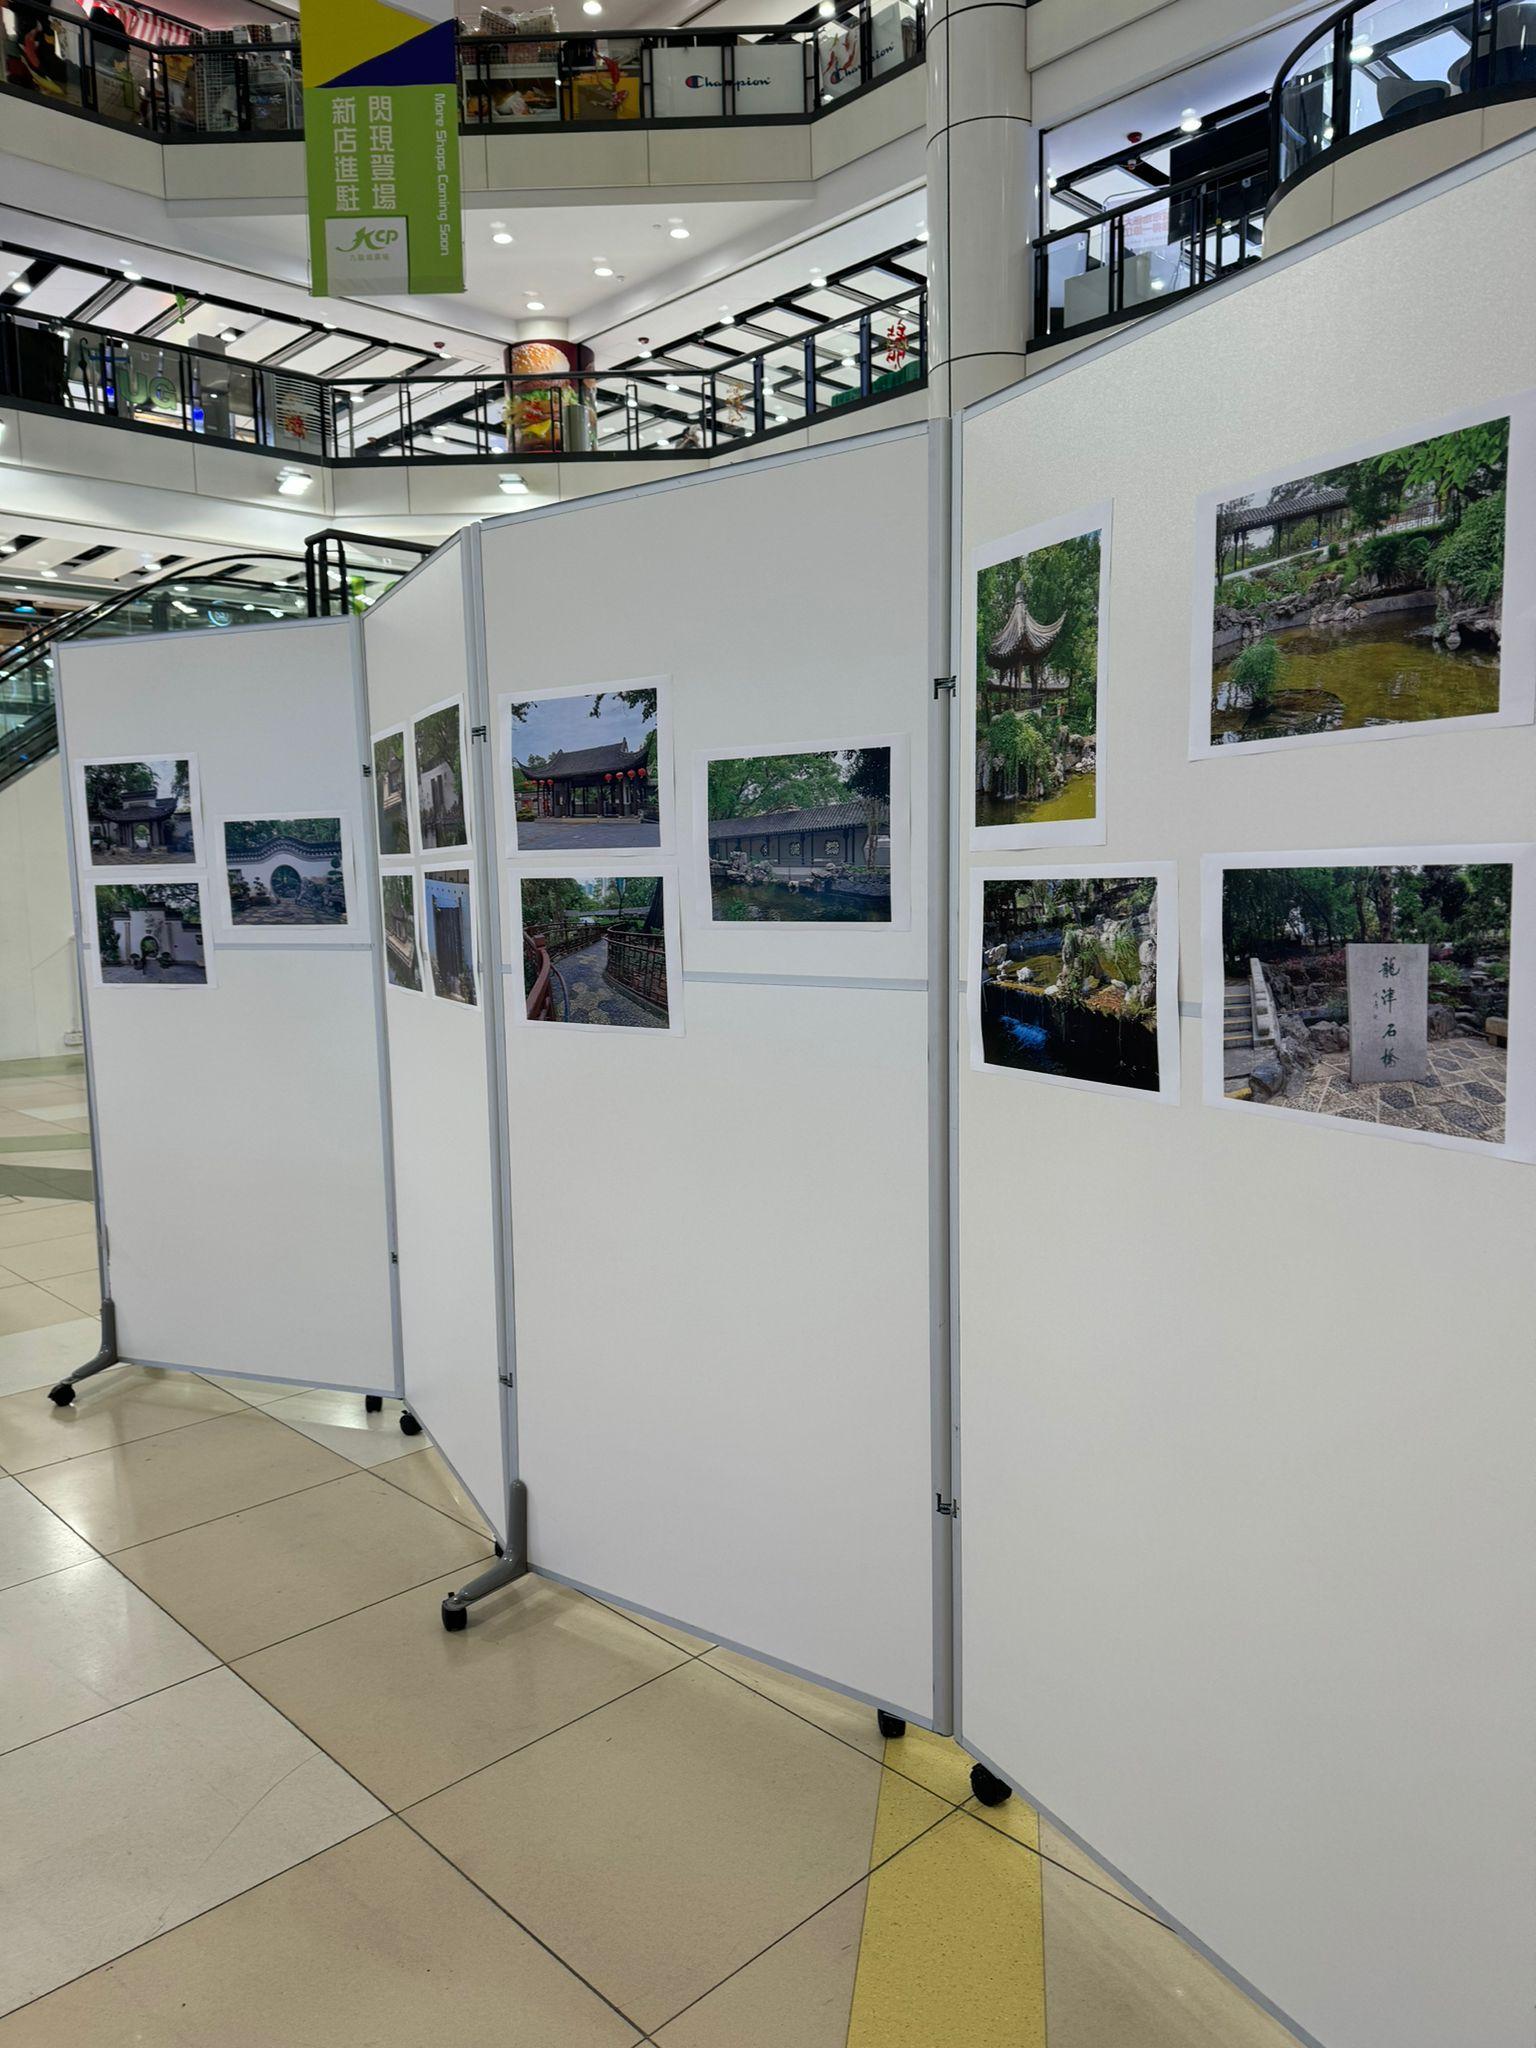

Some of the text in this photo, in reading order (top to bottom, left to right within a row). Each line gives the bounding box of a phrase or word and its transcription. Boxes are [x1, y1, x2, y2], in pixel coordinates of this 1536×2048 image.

[331, 97, 360, 212] 新店進駐
[368, 95, 397, 210] 閃現登場
[435, 93, 451, 256] More Shops Coming Soon
